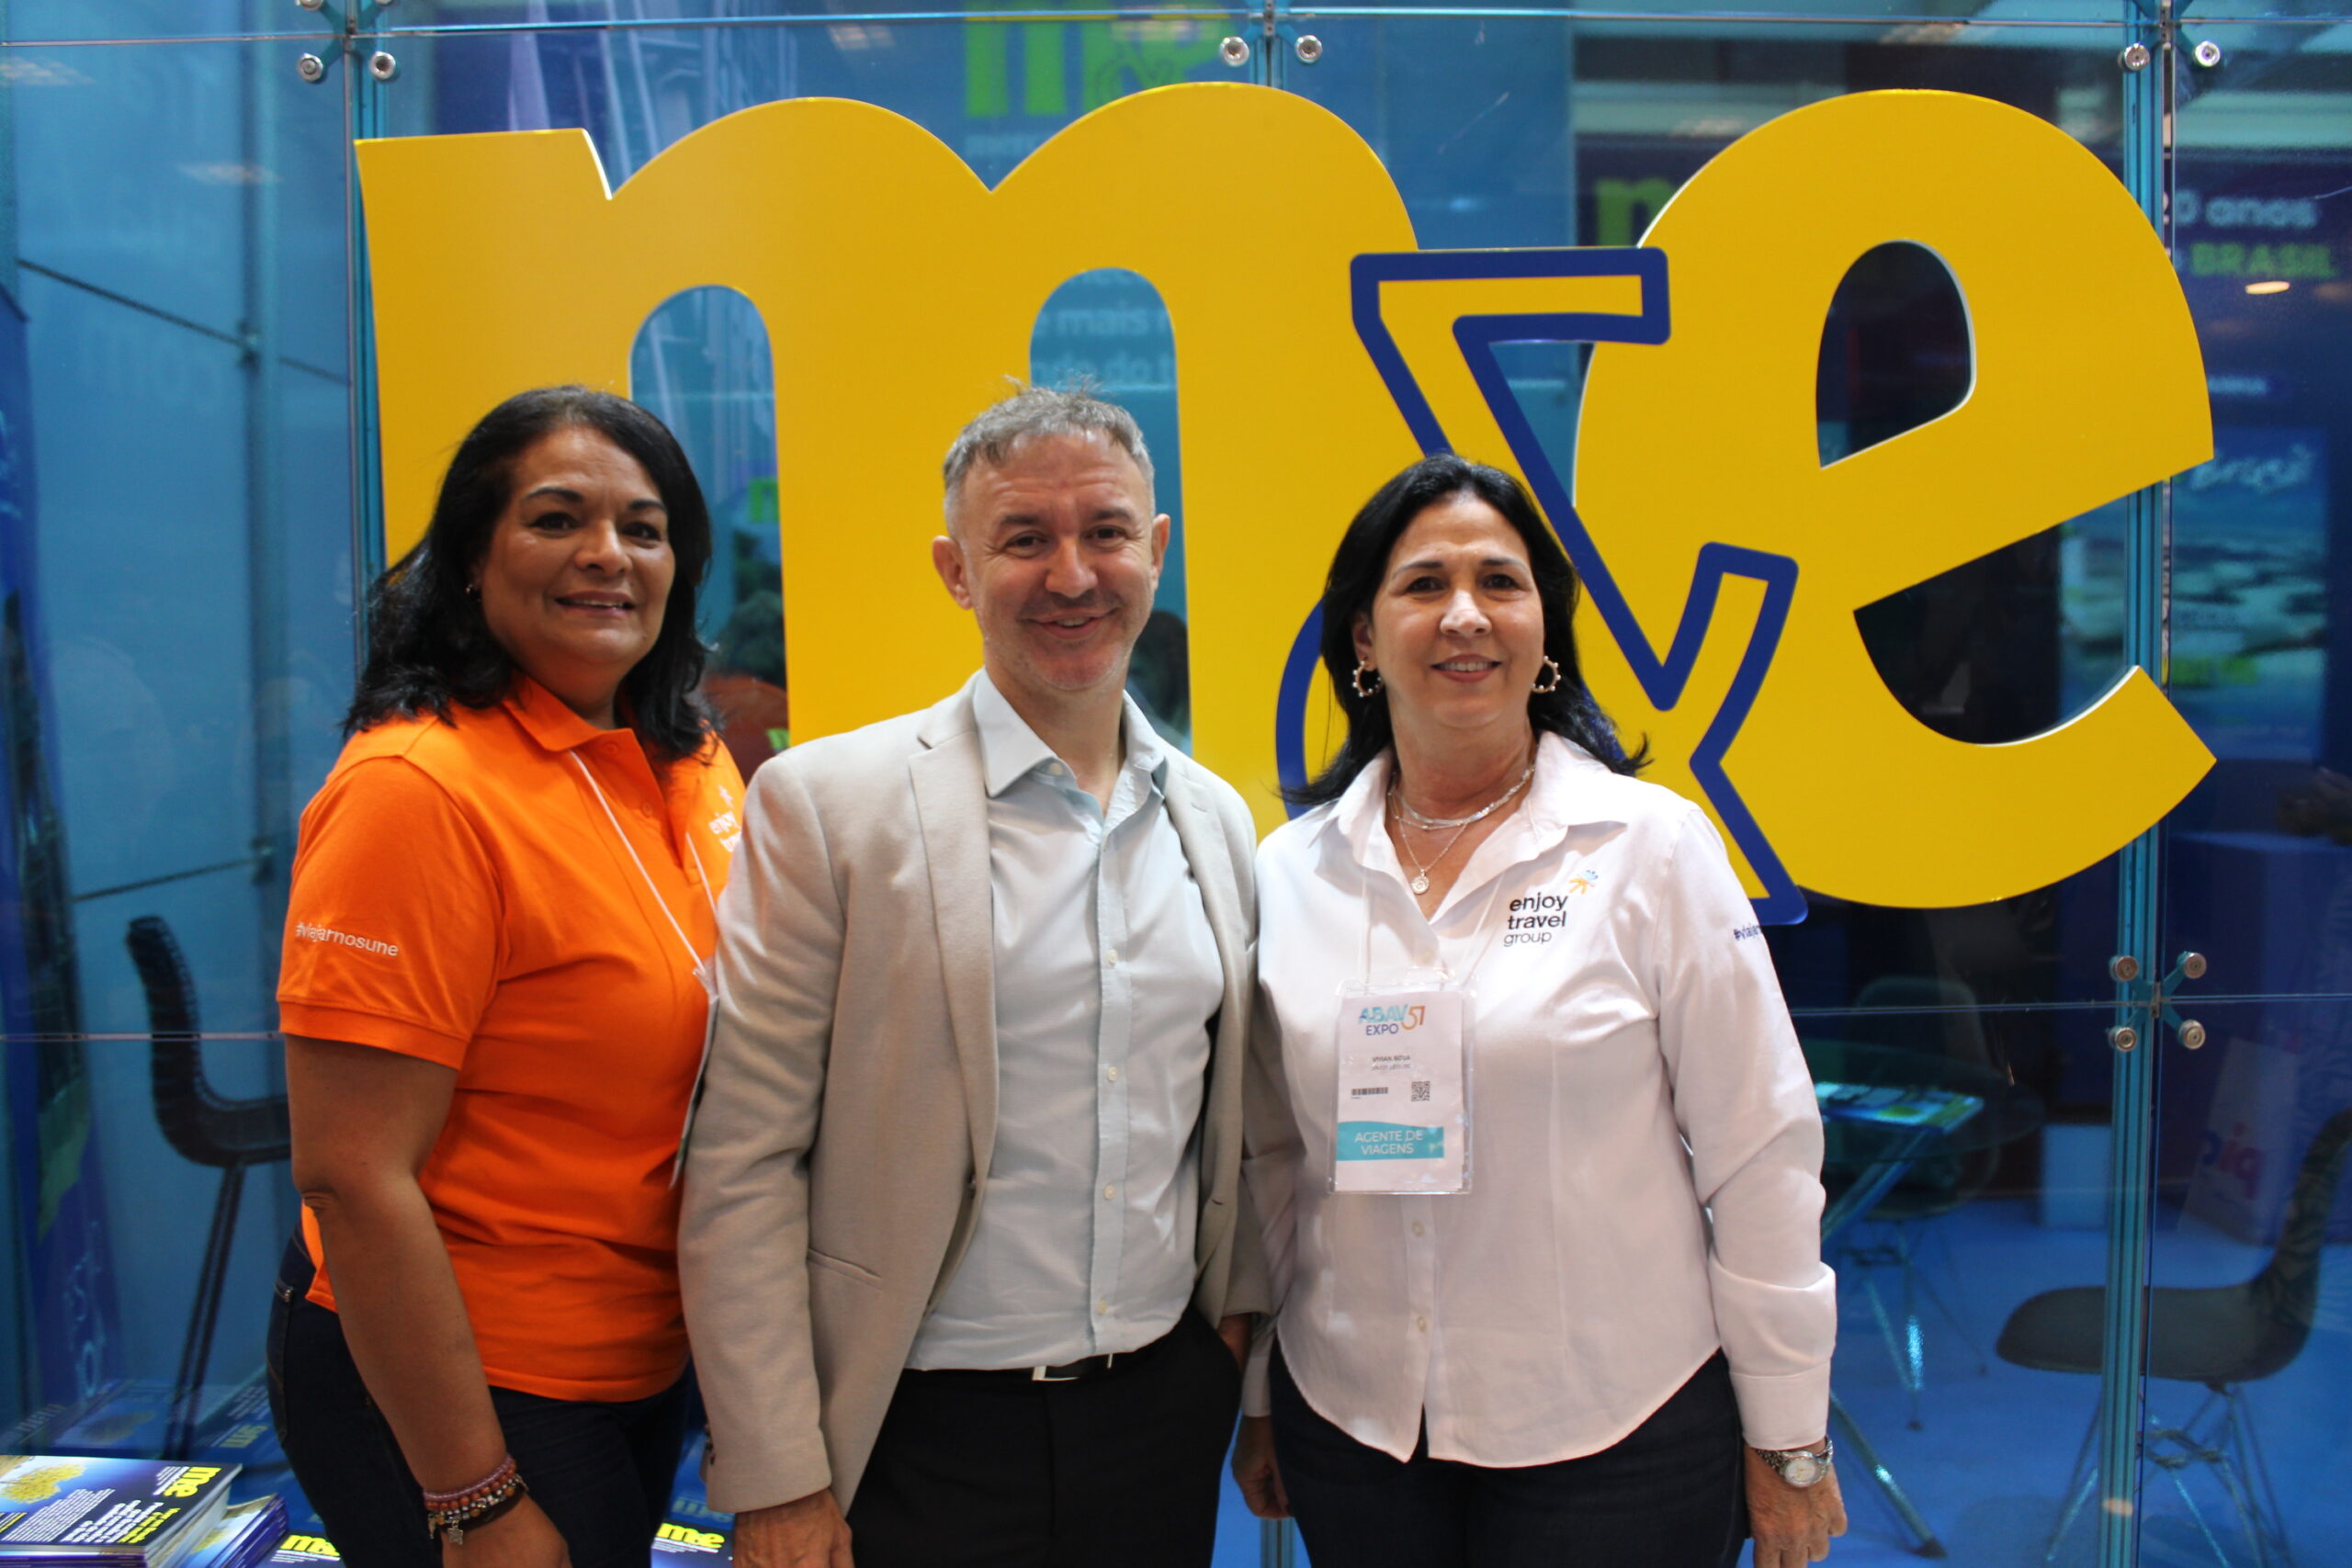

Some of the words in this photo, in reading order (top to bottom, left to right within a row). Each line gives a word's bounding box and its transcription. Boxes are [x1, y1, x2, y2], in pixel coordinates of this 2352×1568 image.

[2190, 242, 2338, 278] BRASIL
[1510, 892, 1568, 912] enjoy
[1508, 910, 1566, 931] travel
[1503, 931, 1552, 948] group
[1365, 1023, 1399, 1036] EXPO
[1354, 1131, 1403, 1144] AGENTE
[1405, 1130, 1425, 1142] DE
[1362, 1144, 1415, 1156] VIAGENS
